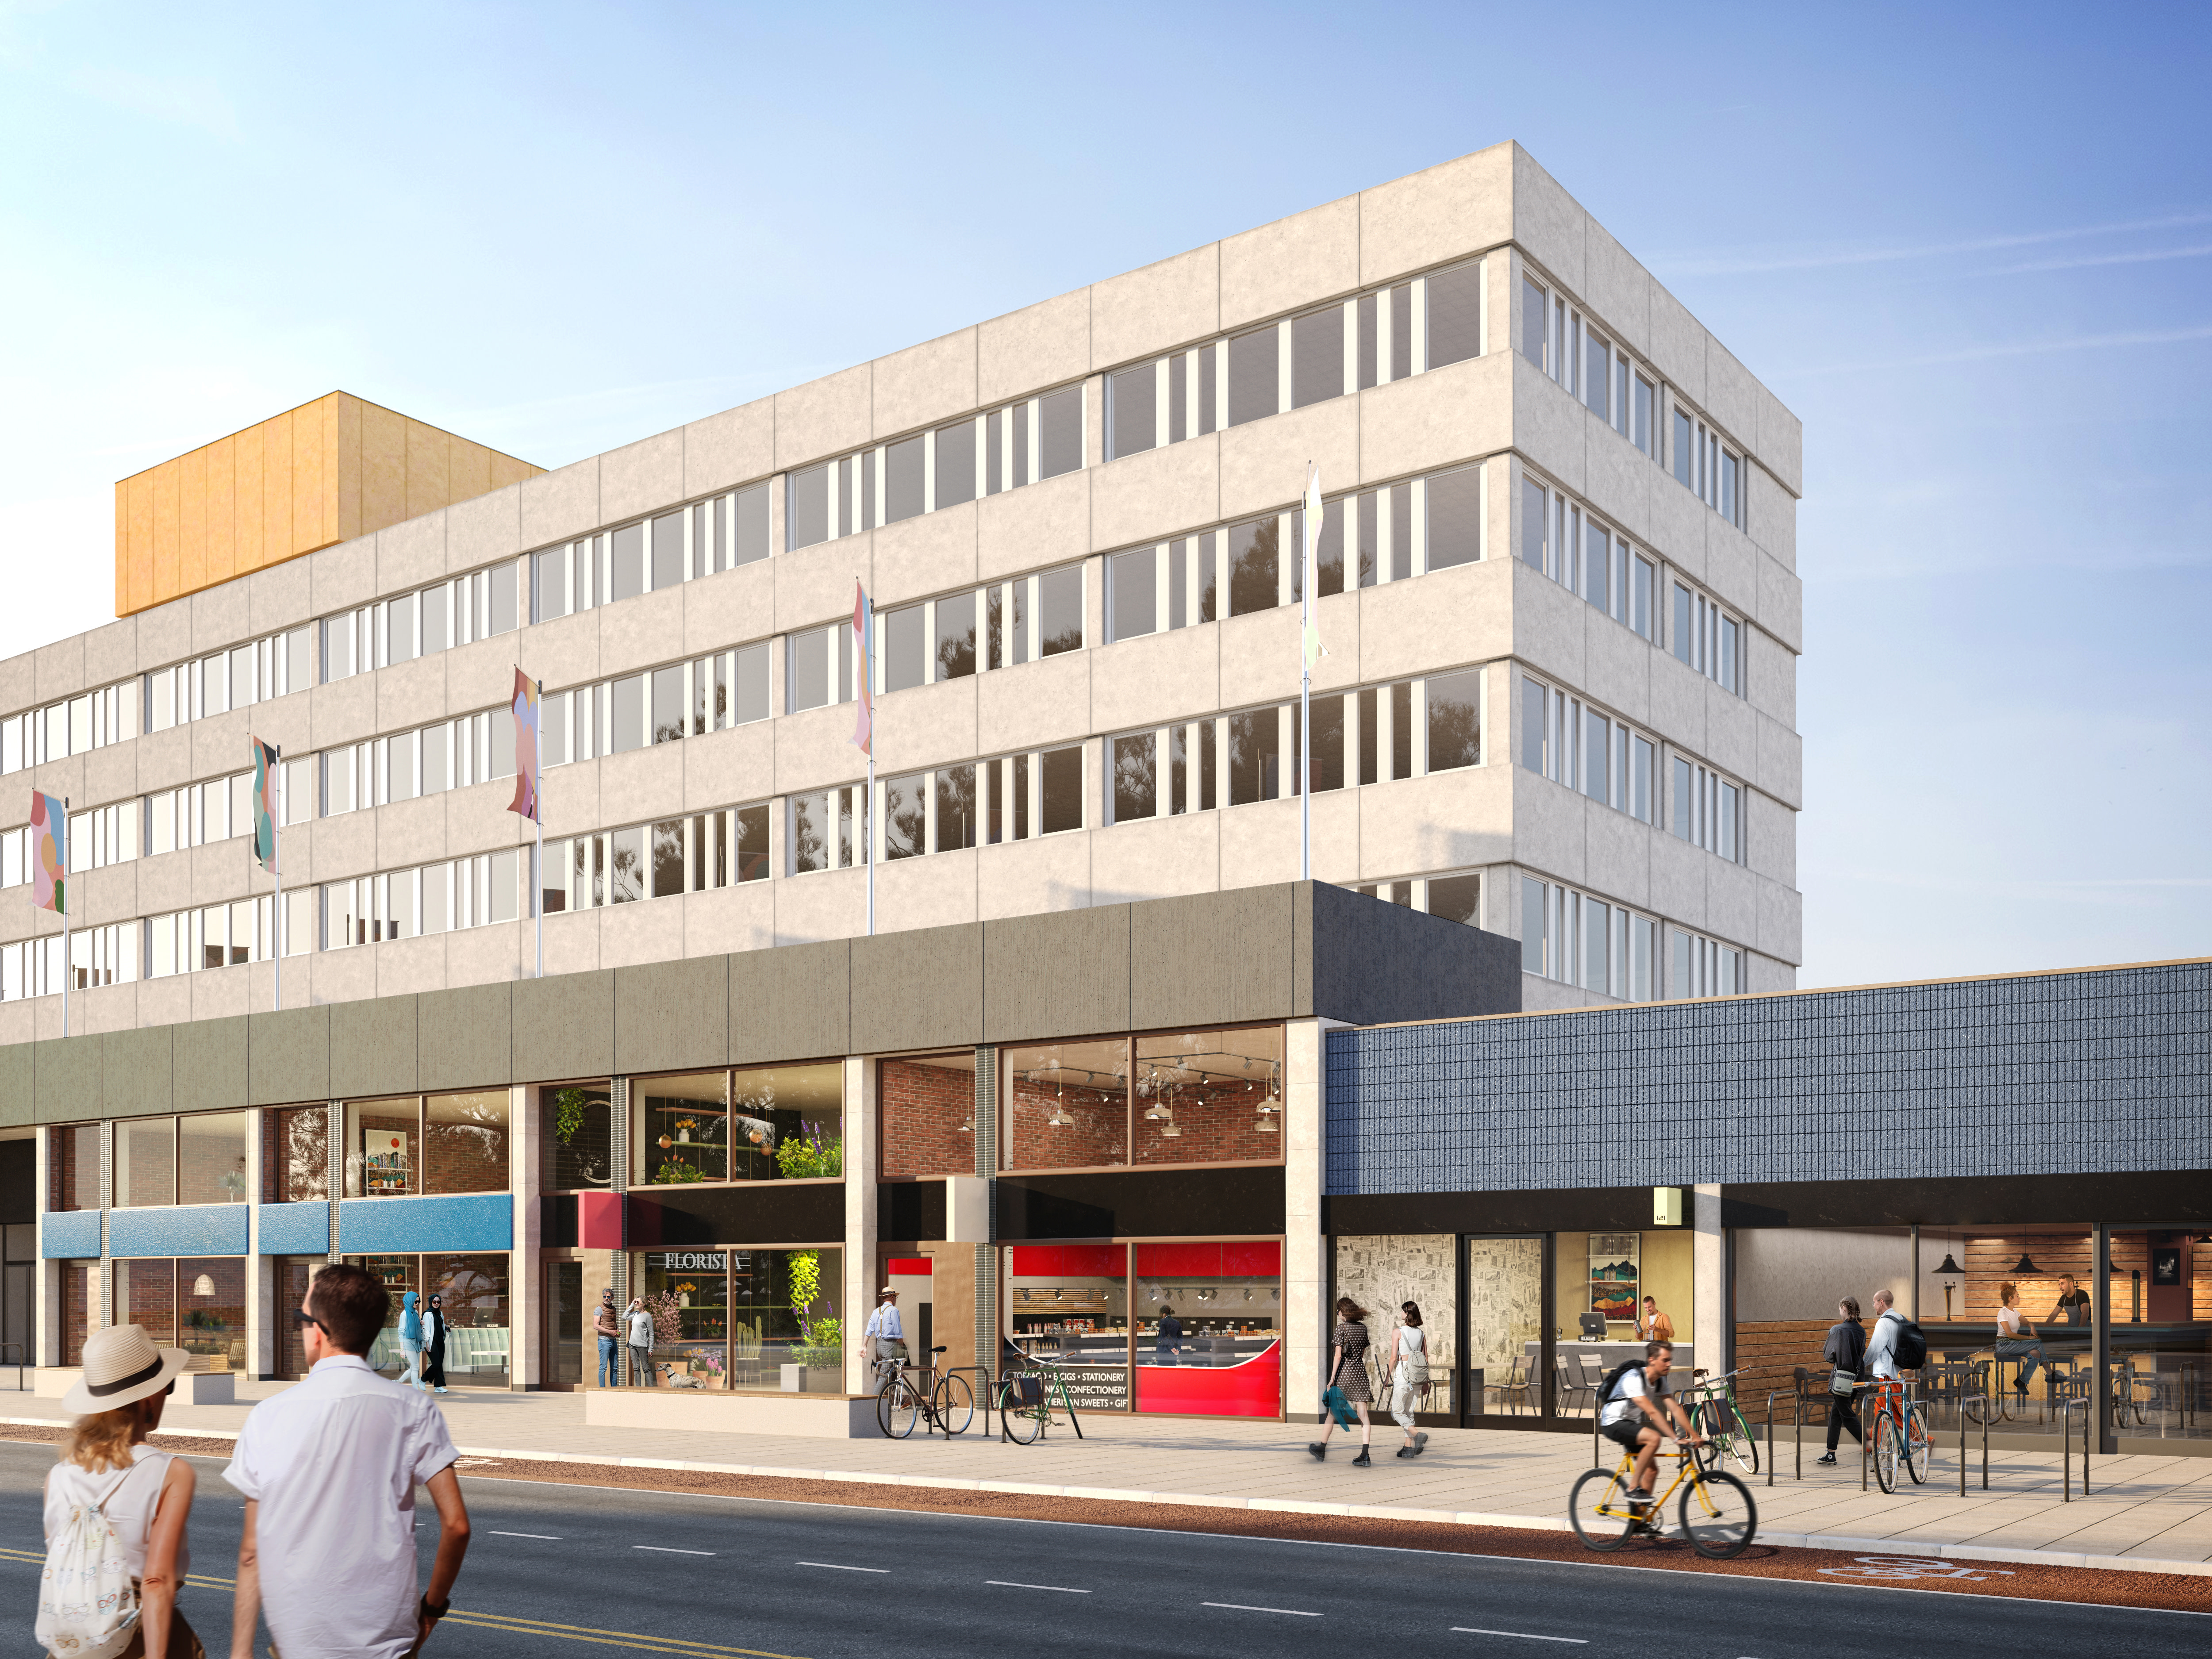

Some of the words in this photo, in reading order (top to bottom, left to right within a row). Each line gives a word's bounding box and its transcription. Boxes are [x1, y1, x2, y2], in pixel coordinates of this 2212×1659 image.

[1053, 1372, 1076, 1381] ECIGS
[1082, 1373, 1125, 1381] STATIONERY
[1066, 1386, 1127, 1394] CONFECTIONERY
[1081, 1398, 1108, 1407] SWEETS
